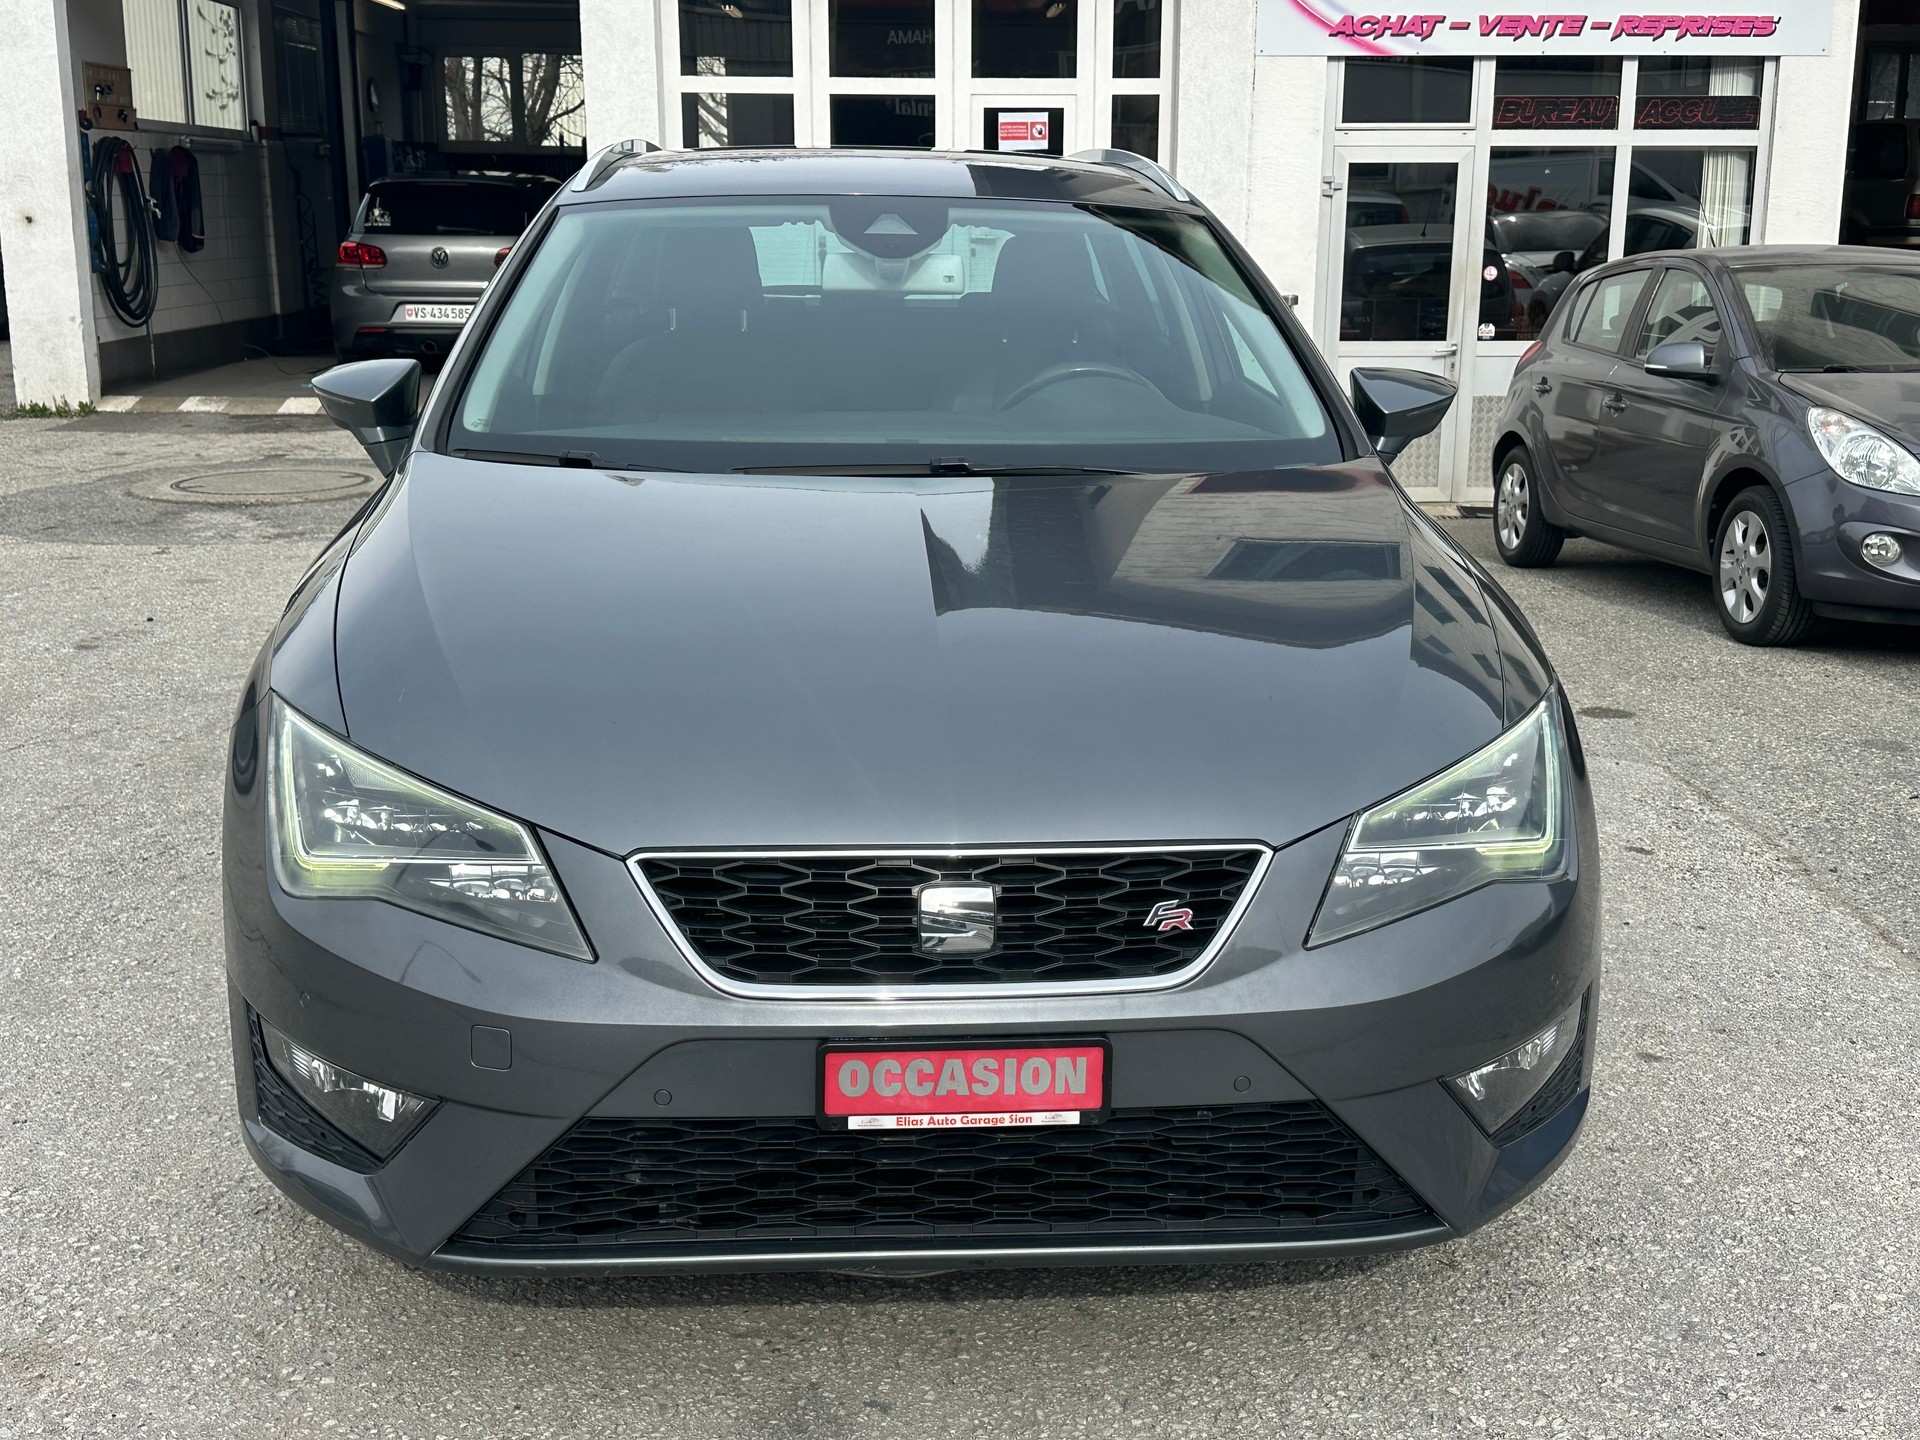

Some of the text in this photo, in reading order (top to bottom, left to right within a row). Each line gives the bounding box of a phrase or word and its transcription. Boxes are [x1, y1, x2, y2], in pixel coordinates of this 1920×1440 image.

[1328, 14, 1447, 42] ACHAT
[1478, 14, 1588, 42] VENTE
[1610, 14, 1782, 42] REPRISES
[1495, 97, 1616, 127] BUREAU
[1637, 97, 1755, 125] ACCU
[1143, 899, 1194, 931] FR
[838, 1056, 1087, 1097] OCCASION
[895, 1114, 1033, 1127] Elias Auto Garage Sion
